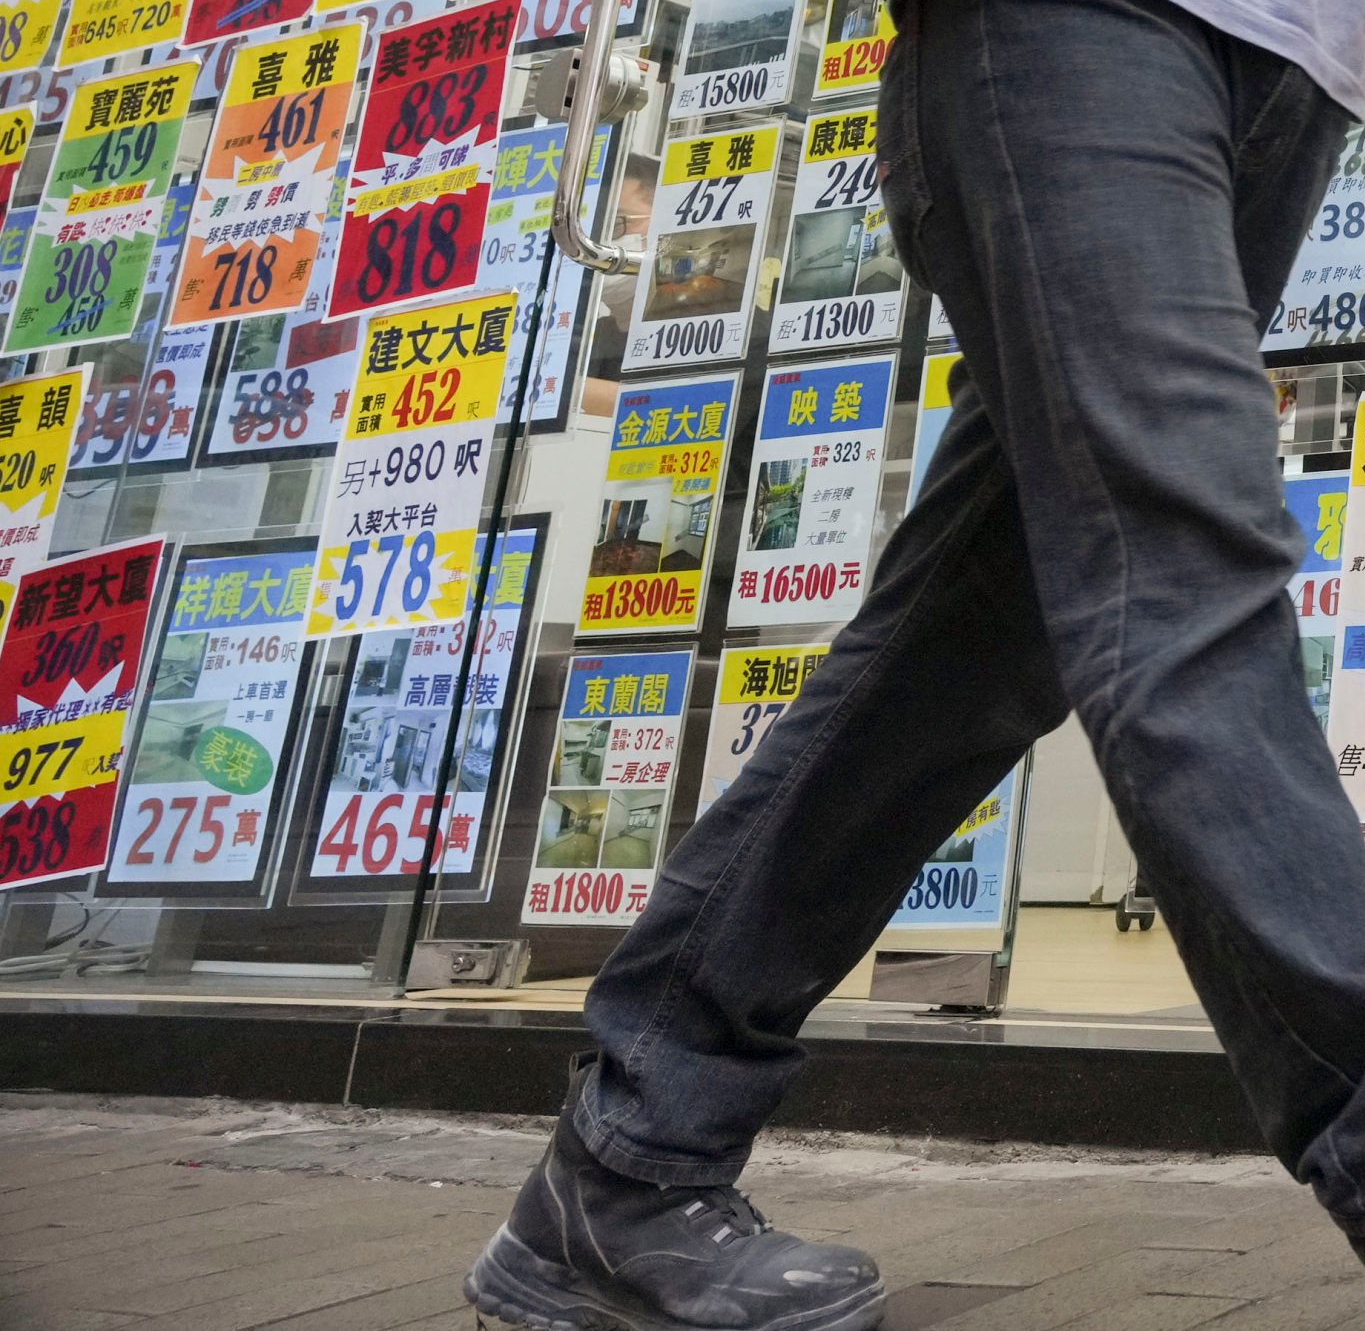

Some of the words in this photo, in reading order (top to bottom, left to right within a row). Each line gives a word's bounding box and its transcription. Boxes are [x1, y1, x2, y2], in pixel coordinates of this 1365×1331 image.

[377, 7, 518, 85] 美孚新村
[84, 75, 180, 130] 寶麗苑
[698, 67, 769, 109] 15800
[258, 86, 327, 154] 461
[88, 121, 159, 182] 459
[208, 246, 278, 311] 718
[357, 202, 460, 304] 818
[365, 306, 512, 377] 建文大廈
[391, 367, 462, 428] 452
[617, 400, 727, 449] 金源大廈
[14, 556, 155, 630] 新望大廈
[334, 530, 437, 621] 578
[603, 576, 677, 619] 13800
[761, 563, 837, 603] 16500
[580, 672, 668, 718] 東蘭閣
[125, 794, 234, 865] 275
[550, 872, 623, 916] 11800
